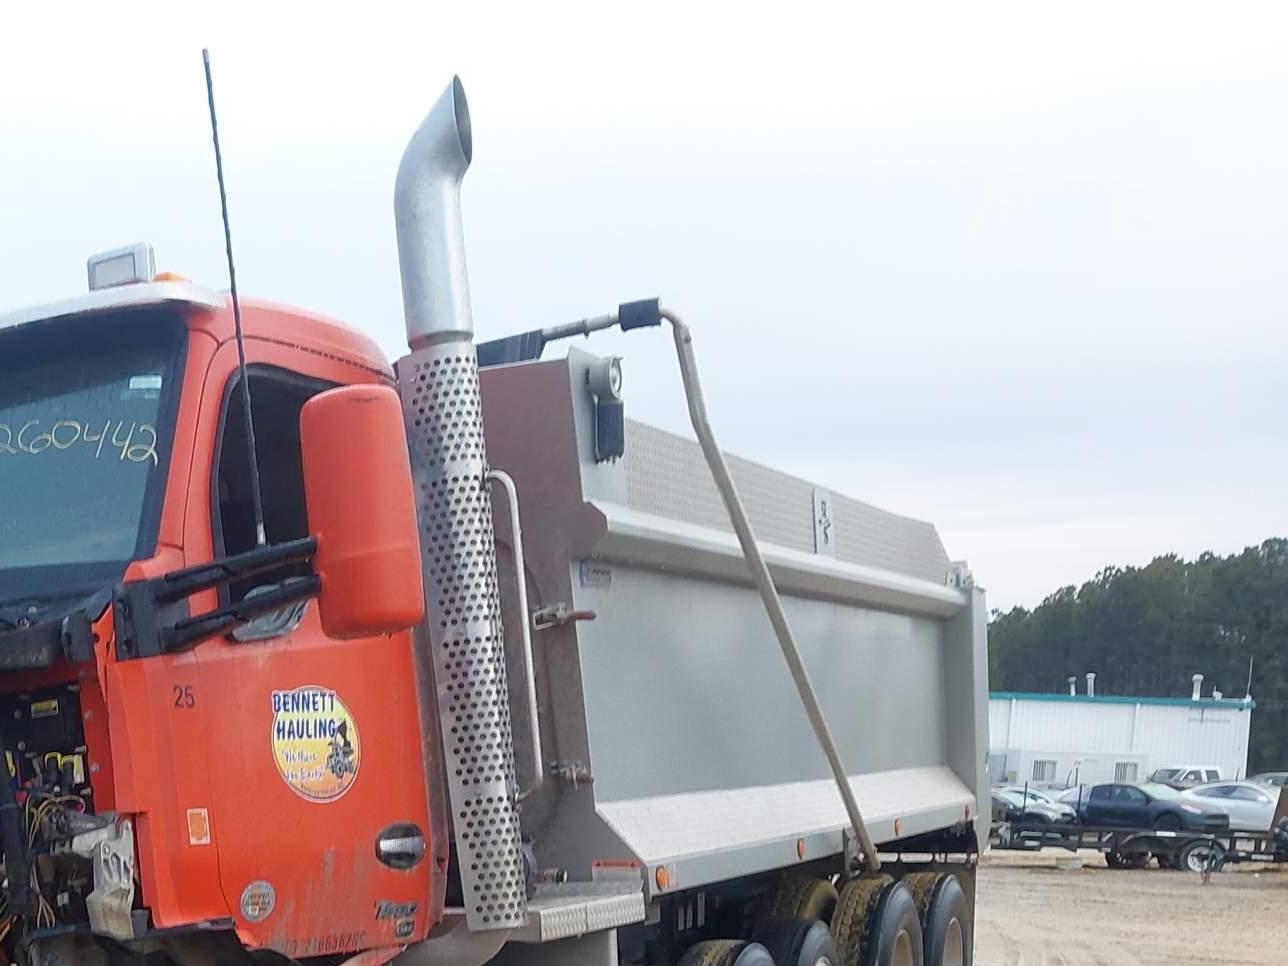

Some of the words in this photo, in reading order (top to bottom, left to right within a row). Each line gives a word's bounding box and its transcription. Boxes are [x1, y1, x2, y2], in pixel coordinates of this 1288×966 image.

[173, 684, 195, 709] 25
[273, 693, 335, 712] BENNETT
[276, 719, 336, 740] HAULING
